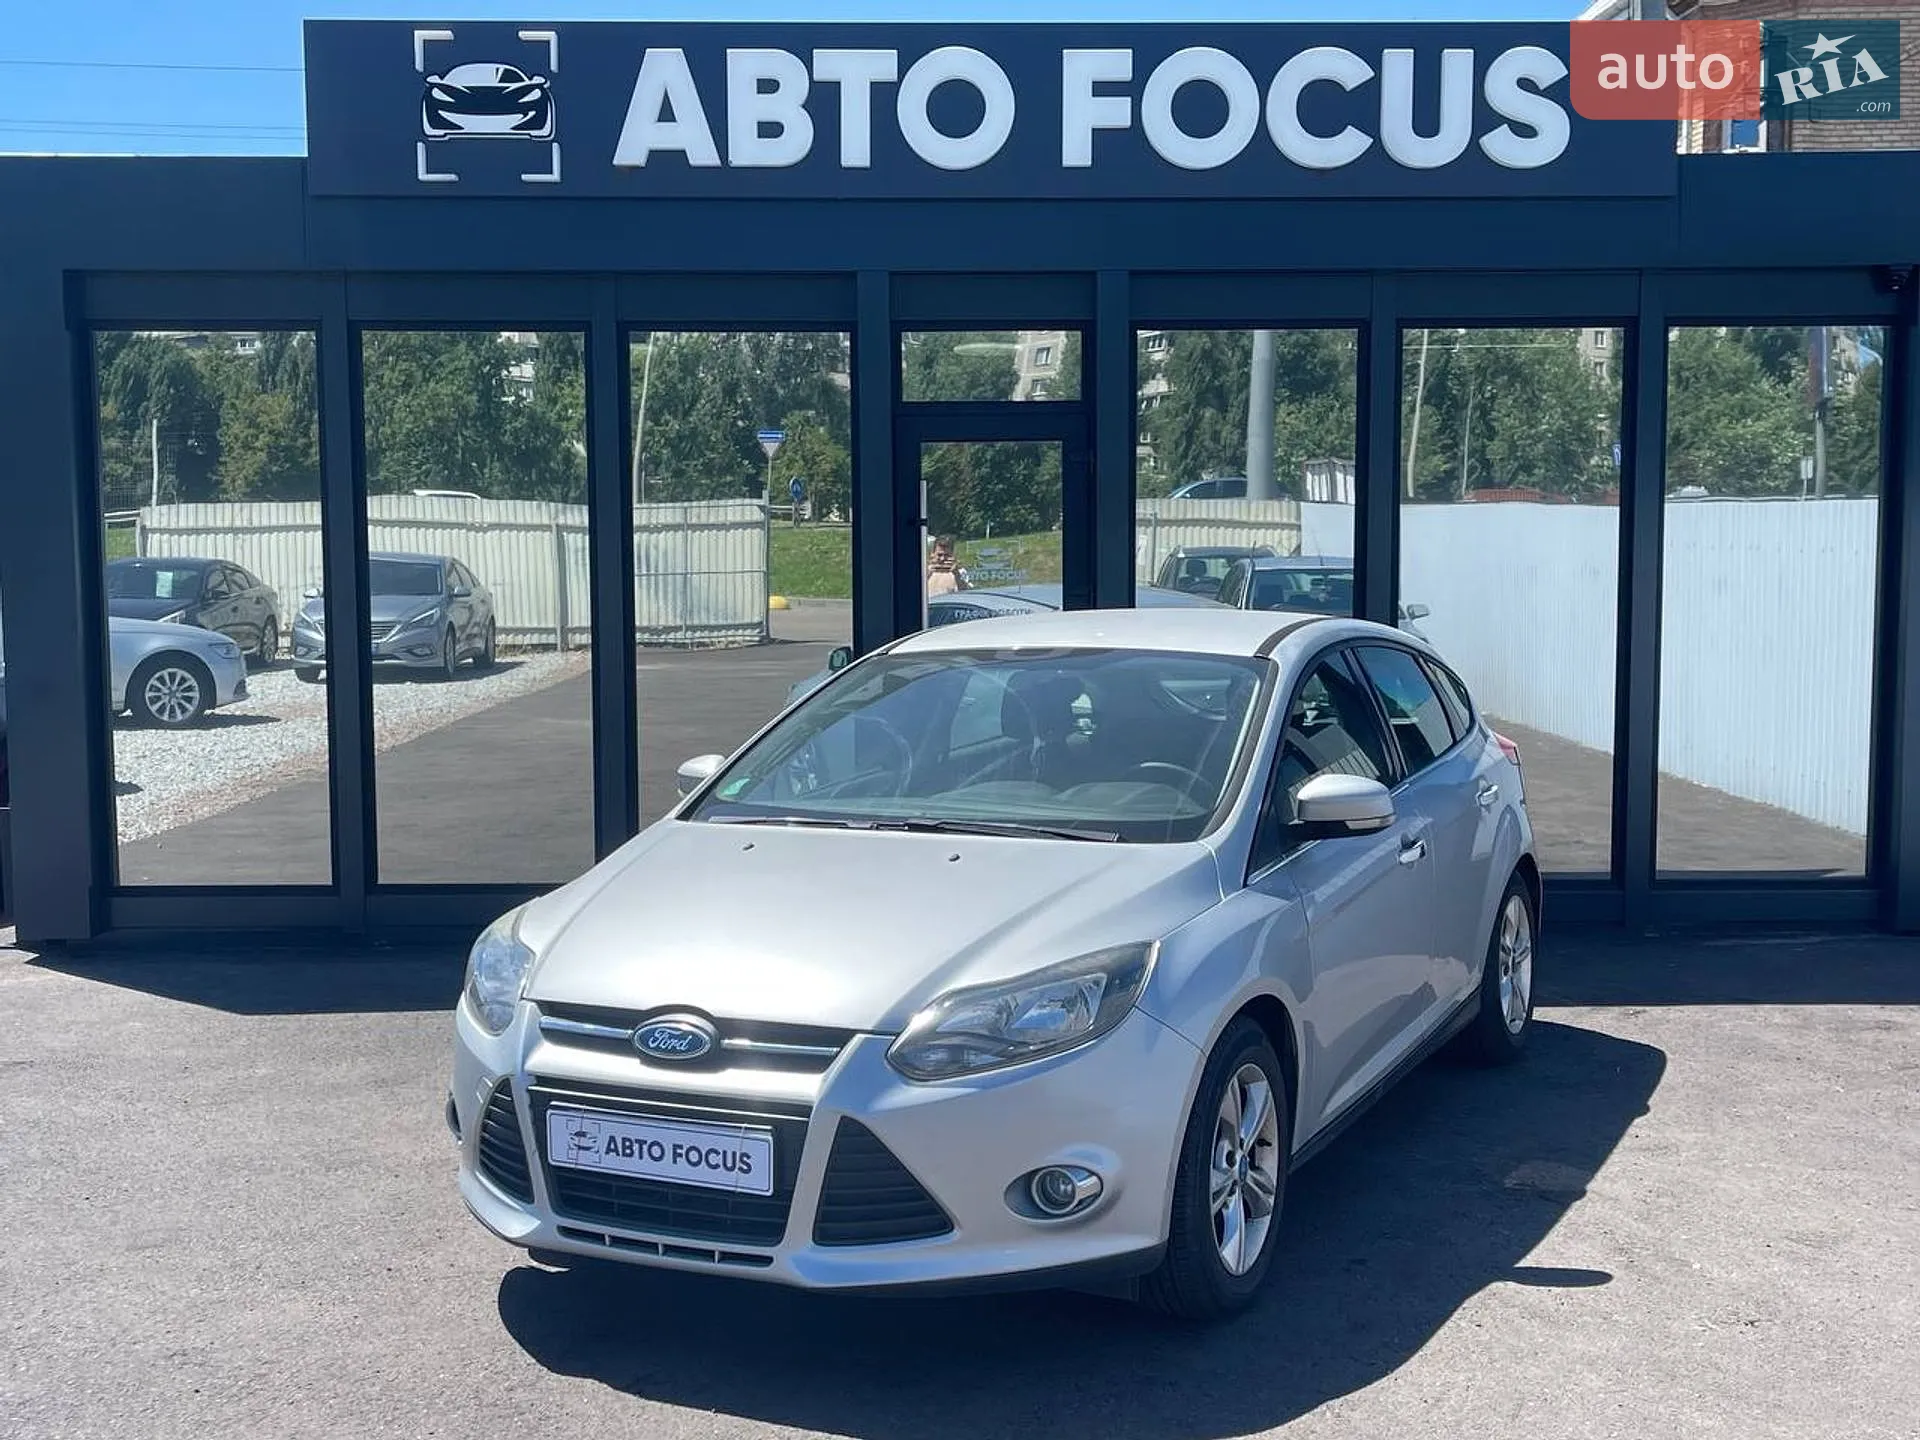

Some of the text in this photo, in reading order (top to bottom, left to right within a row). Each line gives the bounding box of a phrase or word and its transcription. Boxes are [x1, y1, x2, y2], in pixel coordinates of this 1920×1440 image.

[612, 45, 1571, 170] АВТО FOCUS
[648, 1027, 693, 1051] Ford
[605, 1135, 753, 1174] АВТО FOCUS
